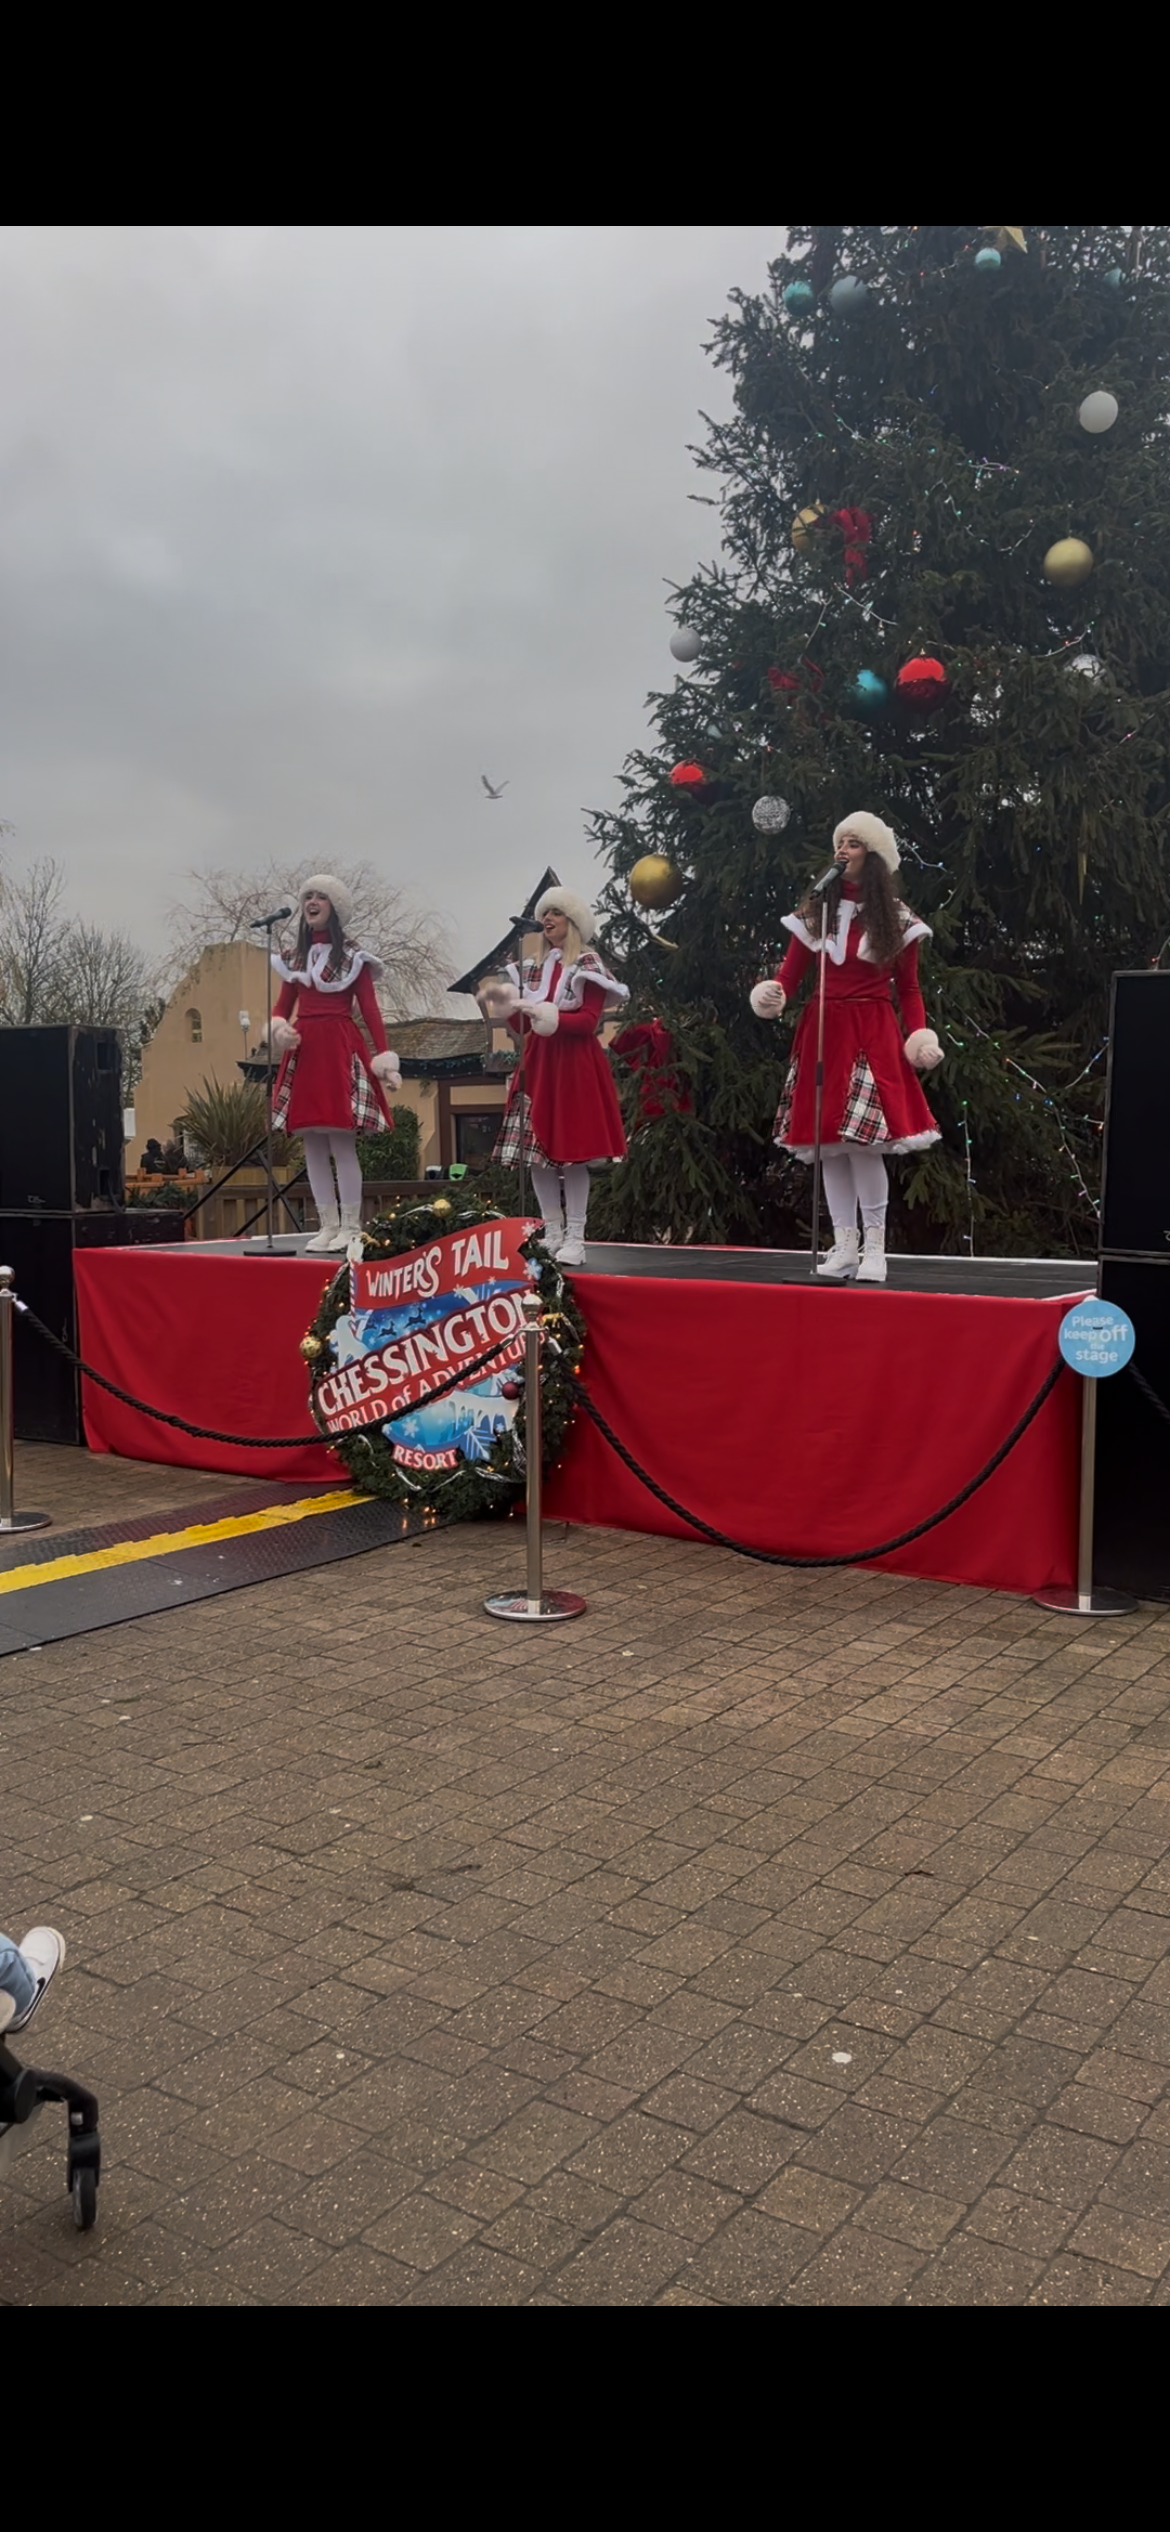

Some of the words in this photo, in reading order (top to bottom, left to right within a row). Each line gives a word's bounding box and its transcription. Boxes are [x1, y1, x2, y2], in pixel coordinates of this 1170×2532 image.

[366, 1246, 442, 1300] WINTER'S
[451, 1230, 510, 1277] TAIL
[1072, 1316, 1114, 1327] Please
[1064, 1328, 1097, 1342] keep
[1100, 1324, 1128, 1342] off
[1076, 1349, 1118, 1364] stage
[327, 1399, 388, 1433] WORLD
[391, 1384, 412, 1411] of
[393, 1445, 458, 1470] RESORT
